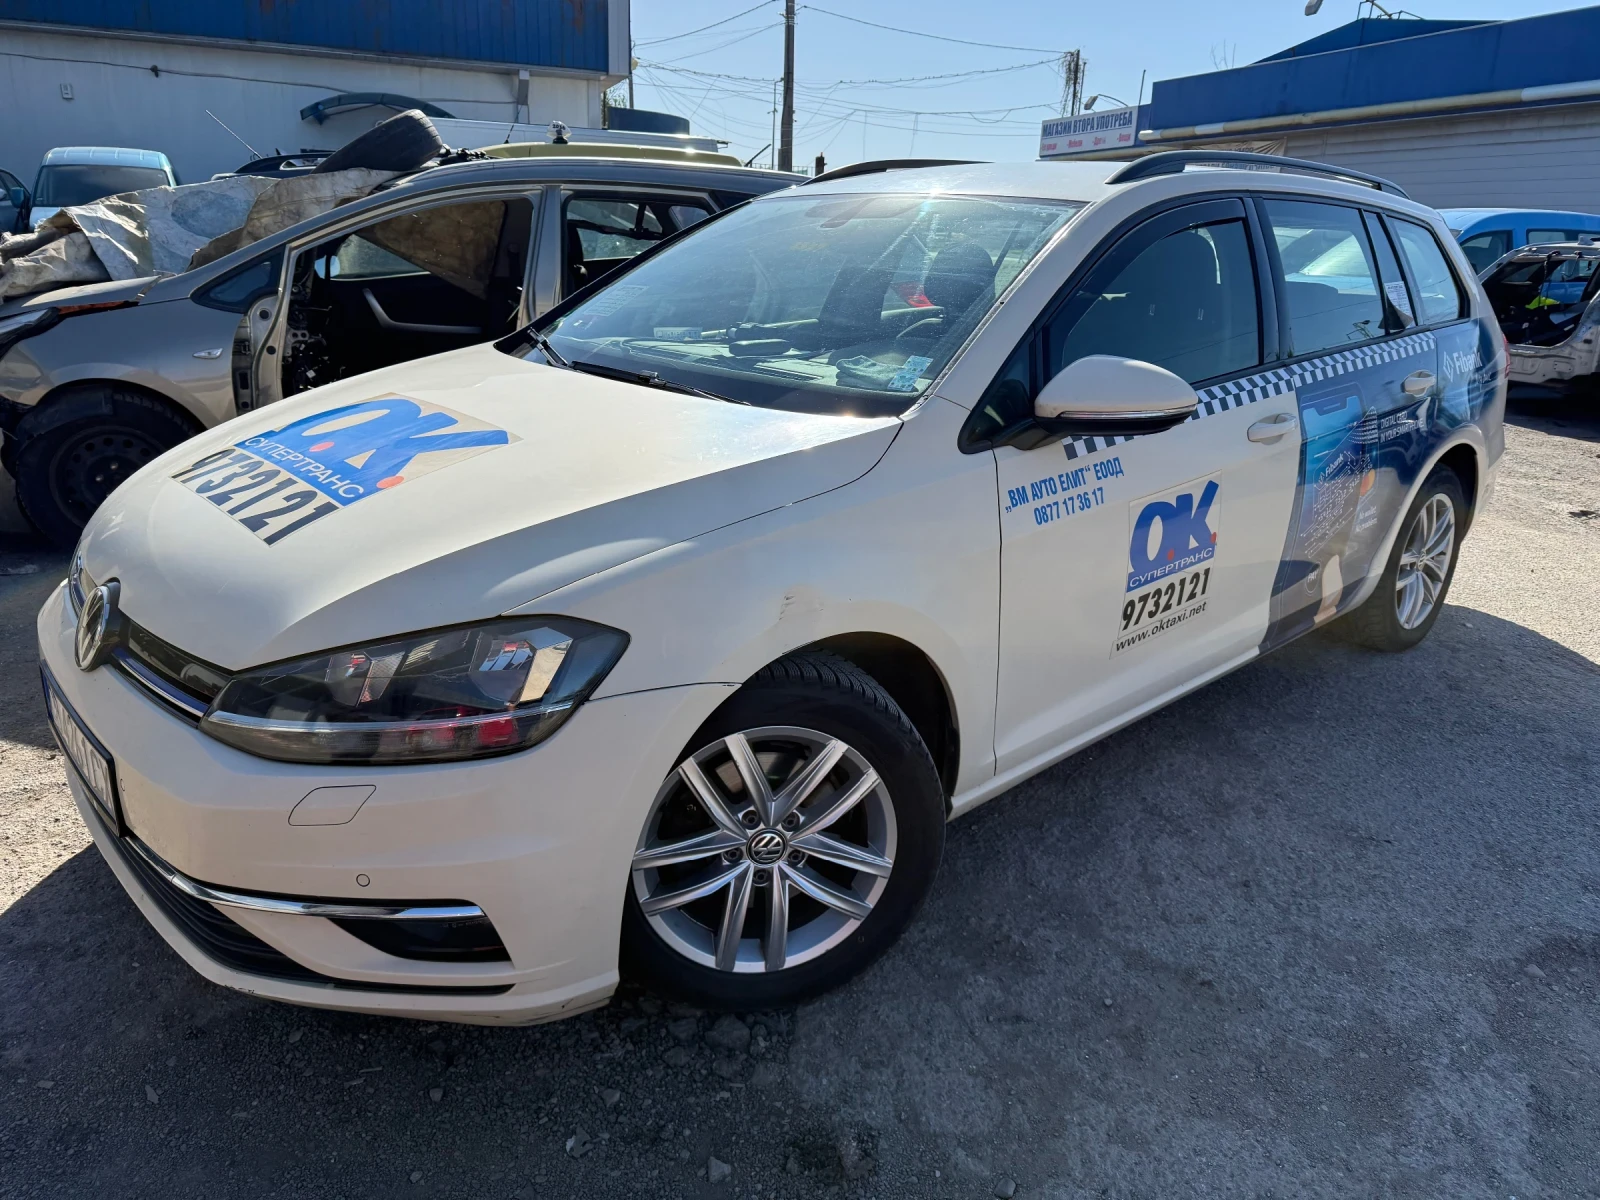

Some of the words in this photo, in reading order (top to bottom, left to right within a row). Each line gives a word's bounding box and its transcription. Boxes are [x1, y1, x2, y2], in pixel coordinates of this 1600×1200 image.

[1043, 120, 1072, 137] МАГАЗИН
[1073, 117, 1095, 133] ВТОРА
[1096, 111, 1133, 130] УПОТРЕБА
[1453, 347, 1483, 374] Fibank
[245, 436, 364, 498] СУПЕРТРАНС
[1030, 477, 1058, 501] АУТО
[1093, 457, 1124, 481] ЕООД
[171, 448, 340, 546] 9732121
[1034, 497, 1062, 526] 0877
[1063, 494, 1077, 516] 17
[1077, 492, 1092, 512] 36
[1092, 487, 1105, 507] 17
[1129, 547, 1213, 588] СУПЕРТРАНС
[1121, 567, 1211, 632] 9732121
[1115, 601, 1207, 652] www.oktaxi.net
